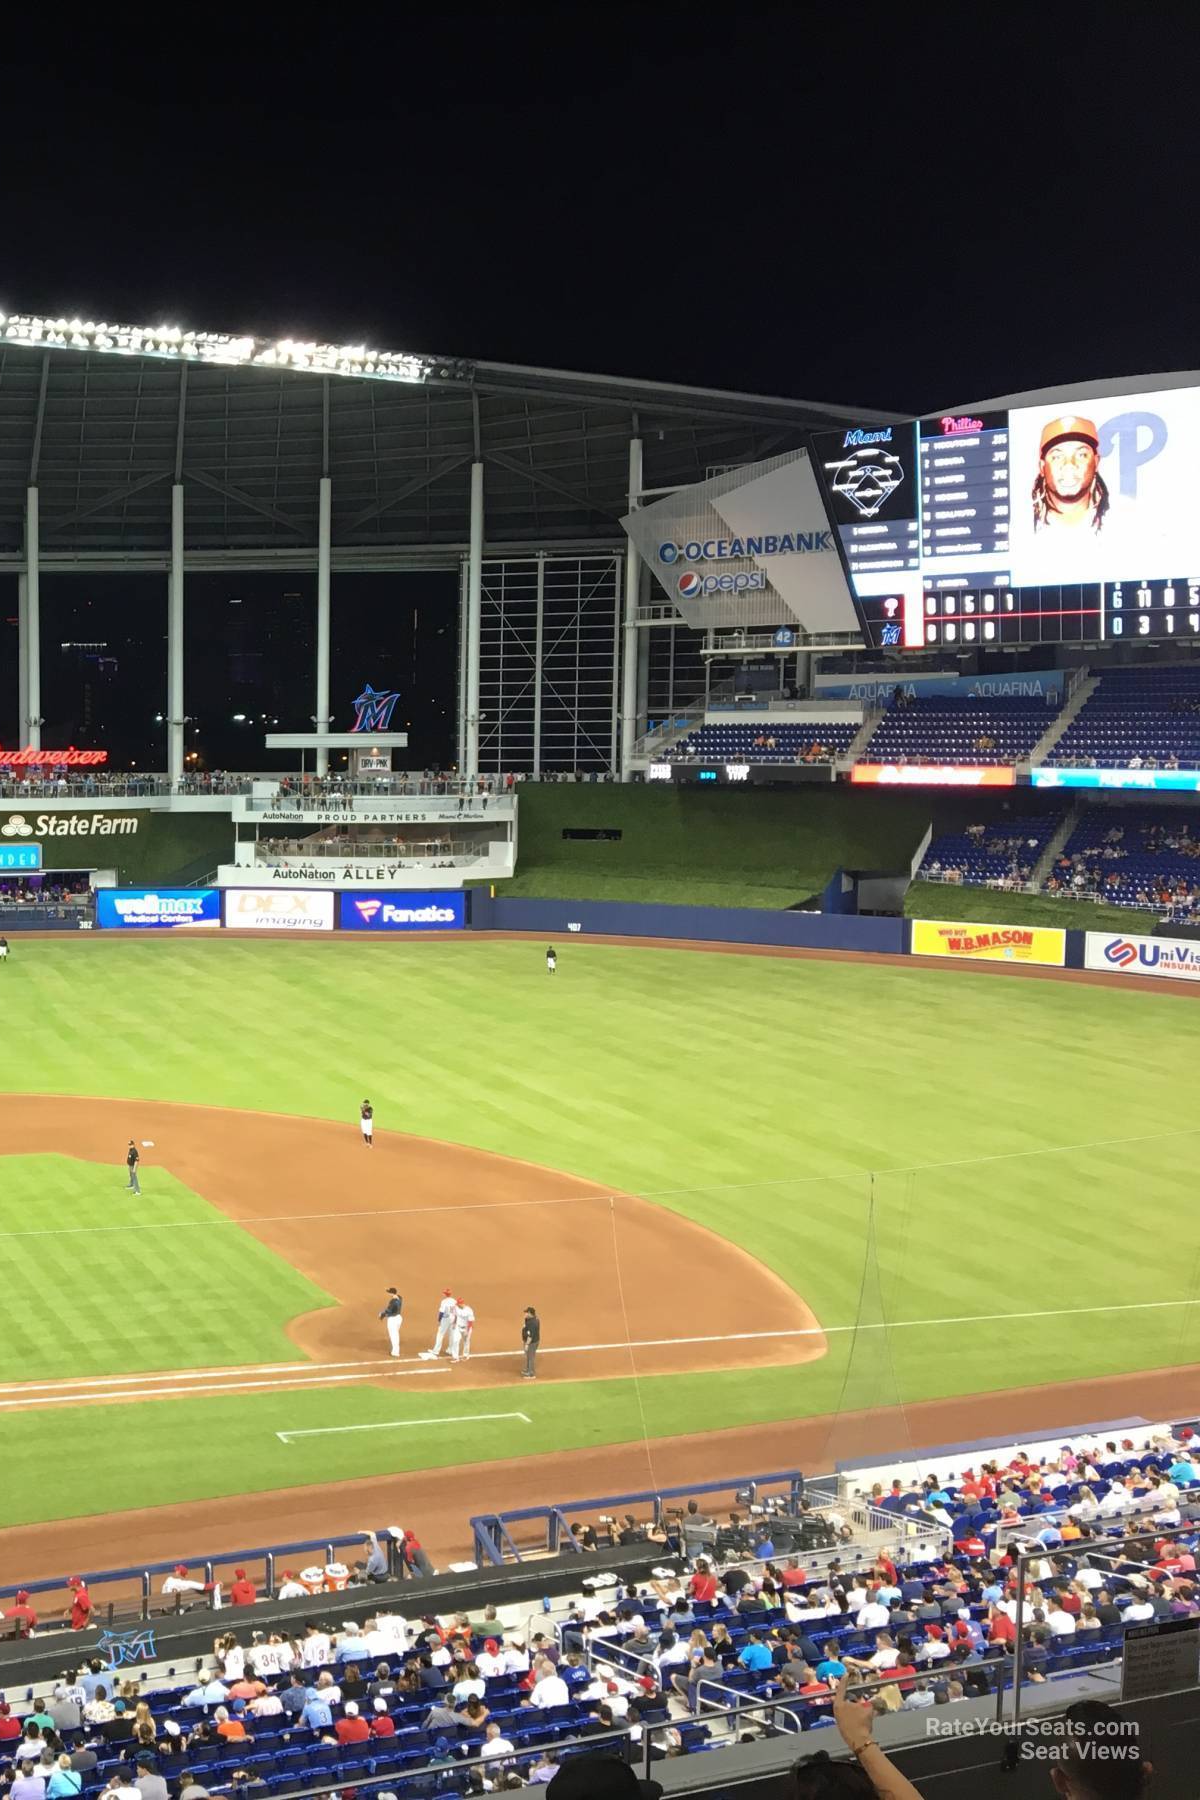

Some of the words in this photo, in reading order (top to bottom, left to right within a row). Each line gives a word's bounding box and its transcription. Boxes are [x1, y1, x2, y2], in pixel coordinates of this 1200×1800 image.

[941, 416, 983, 433] Phillies
[843, 427, 893, 448] Miami
[684, 530, 832, 561] OCEANBANK
[702, 569, 767, 596] pepsi
[1006, 593, 1014, 611] 1
[1112, 591, 1123, 609] 6
[1137, 589, 1152, 608] 11
[1189, 587, 1200, 606] 5
[1112, 617, 1123, 635] 0
[1138, 615, 1150, 634] 3
[1165, 614, 1174, 633] 1
[776, 632, 791, 642] 42
[972, 680, 1044, 697] AQUAFINA
[262, 812, 303, 820] AutoNation
[273, 869, 335, 880] AutoNation
[343, 869, 397, 880] ALLEY
[383, 905, 455, 922] Fanatics
[255, 917, 323, 928] imaging
[261, 1653, 276, 1667] 34
[319, 1711, 328, 1724] 3
